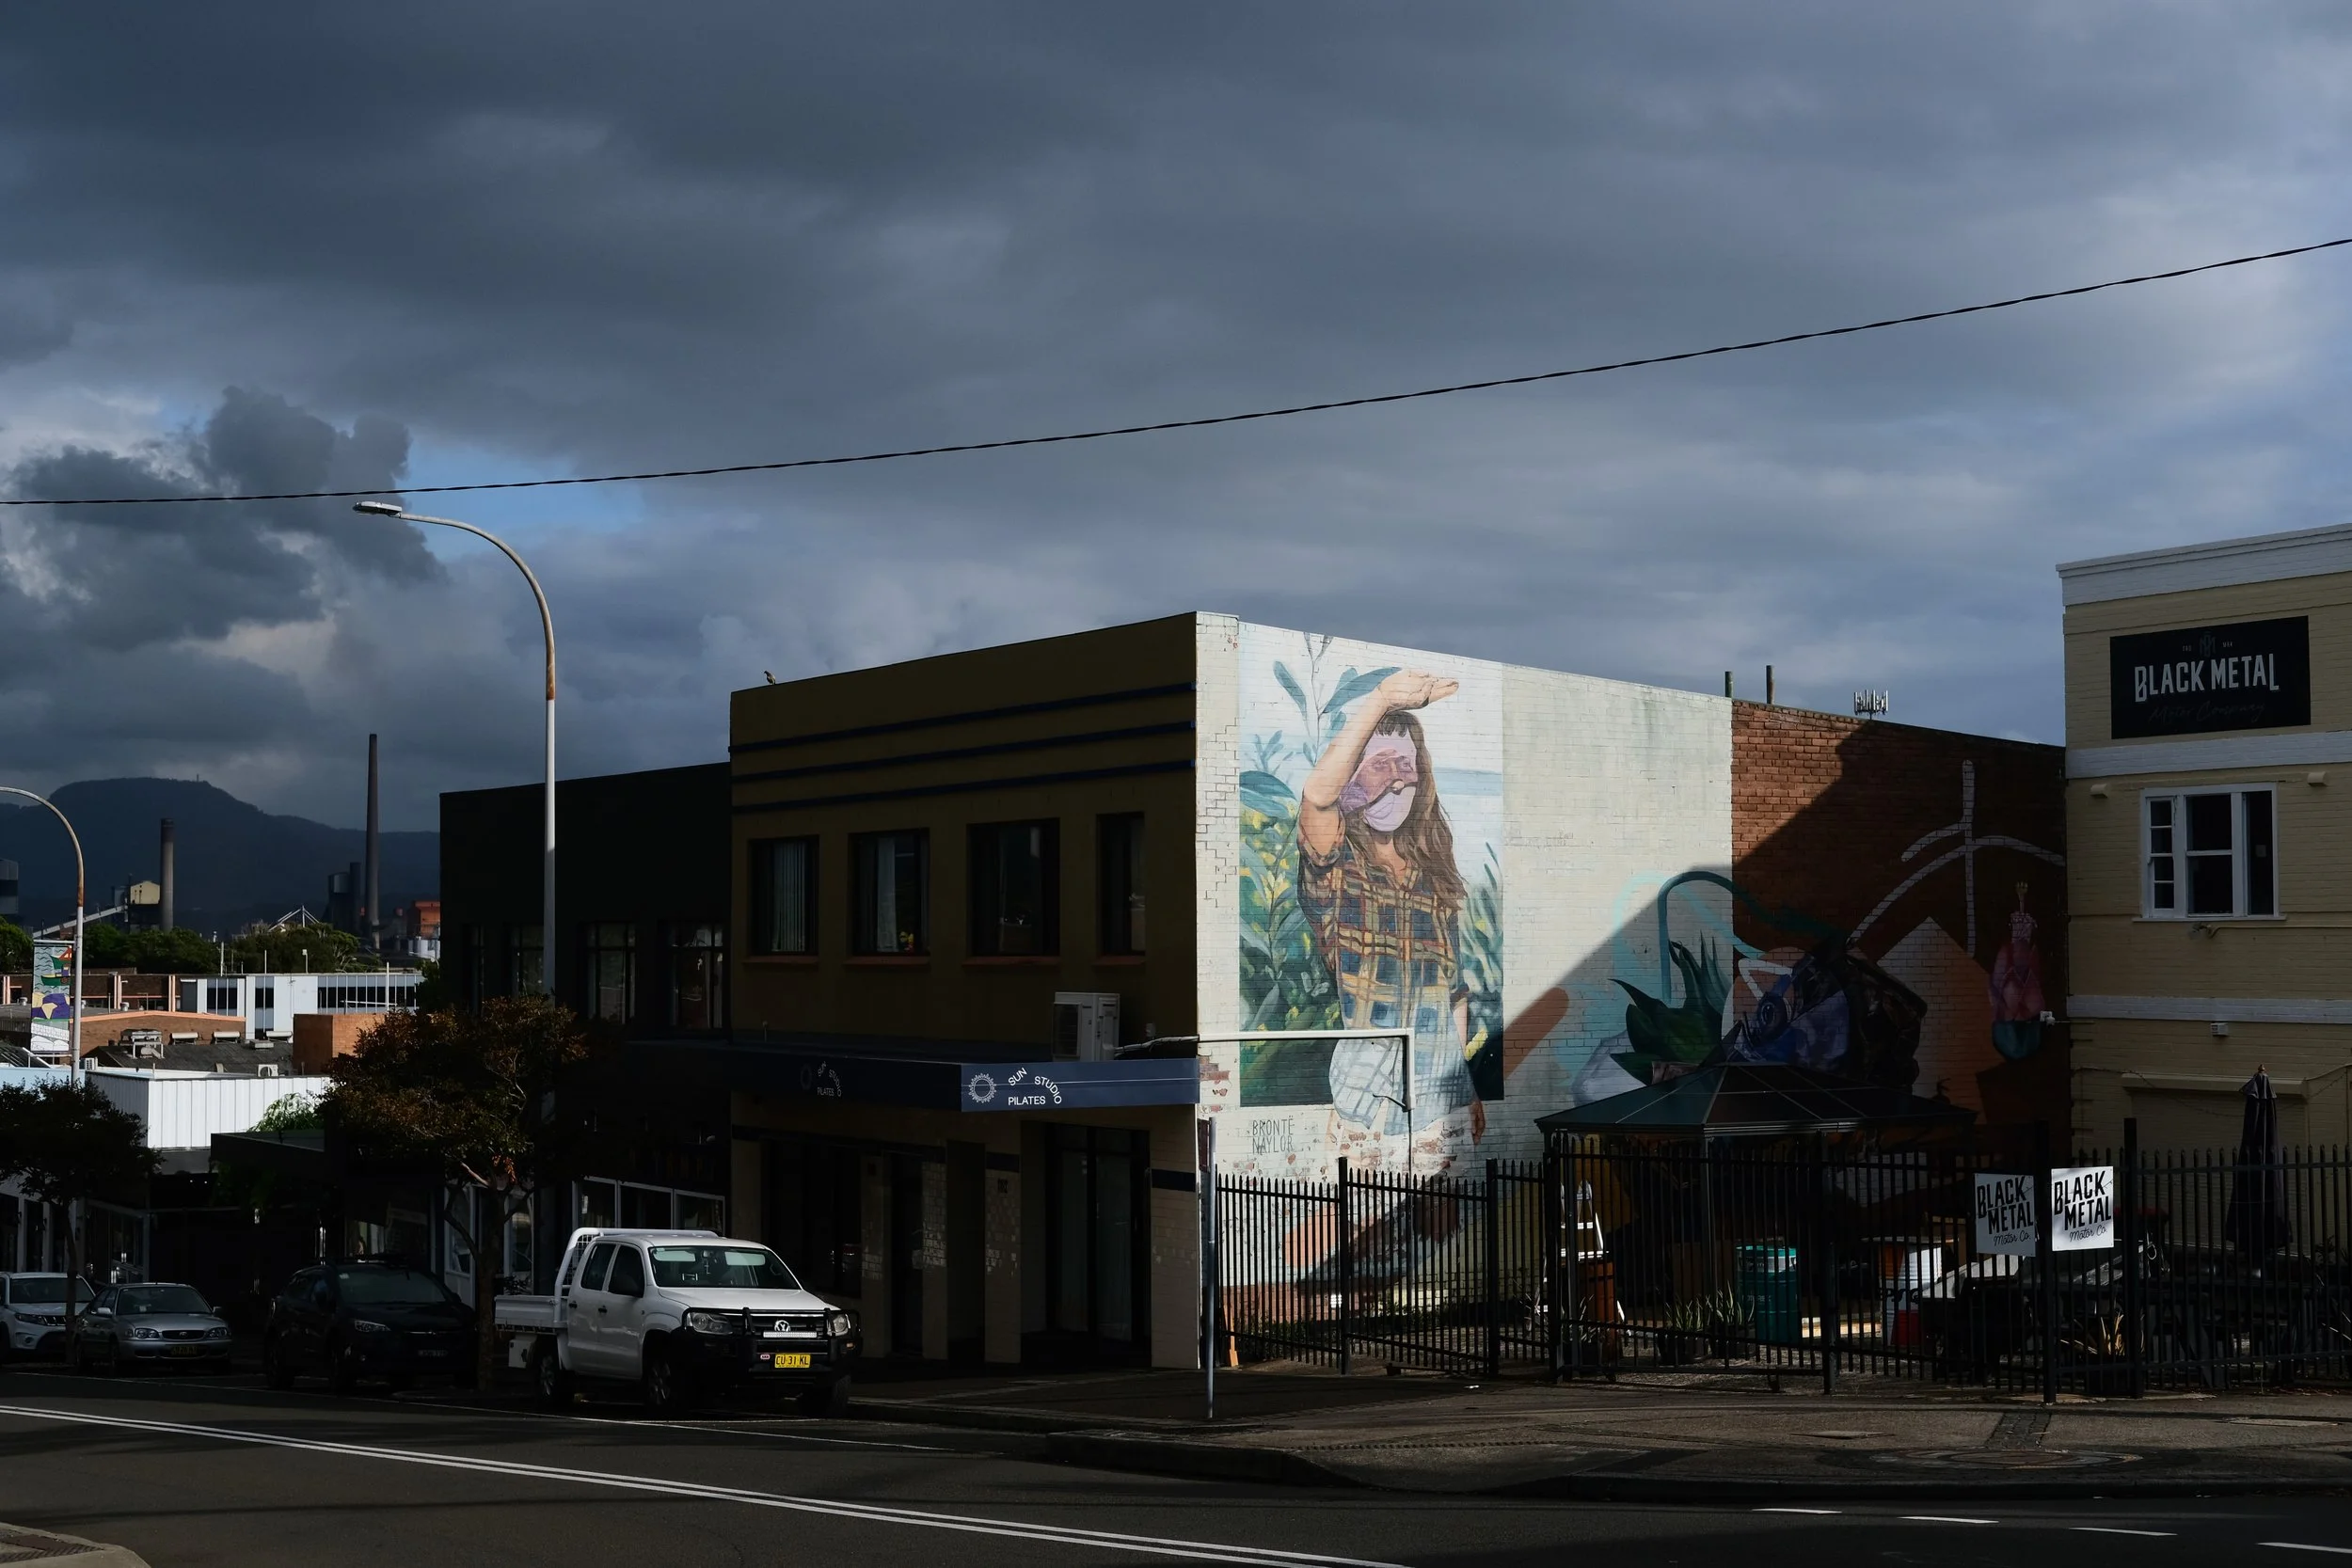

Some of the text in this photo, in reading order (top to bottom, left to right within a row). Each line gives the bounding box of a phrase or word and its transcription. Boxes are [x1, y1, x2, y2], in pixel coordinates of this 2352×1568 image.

[2134, 653, 2280, 703] BLACK METAL
[1008, 1067, 1062, 1104] SUN STUDIO
[1008, 1095, 1046, 1106] PILATES
[1252, 1135, 1295, 1155] NAYLOR
[1977, 1176, 2026, 1219] BLACK
[2054, 1170, 2106, 1215] BLACK
[1987, 1201, 2034, 1235] METAL
[2064, 1196, 2112, 1231] METAL
[1993, 1233, 2018, 1246] Motor
[2069, 1228, 2095, 1243] Motor
